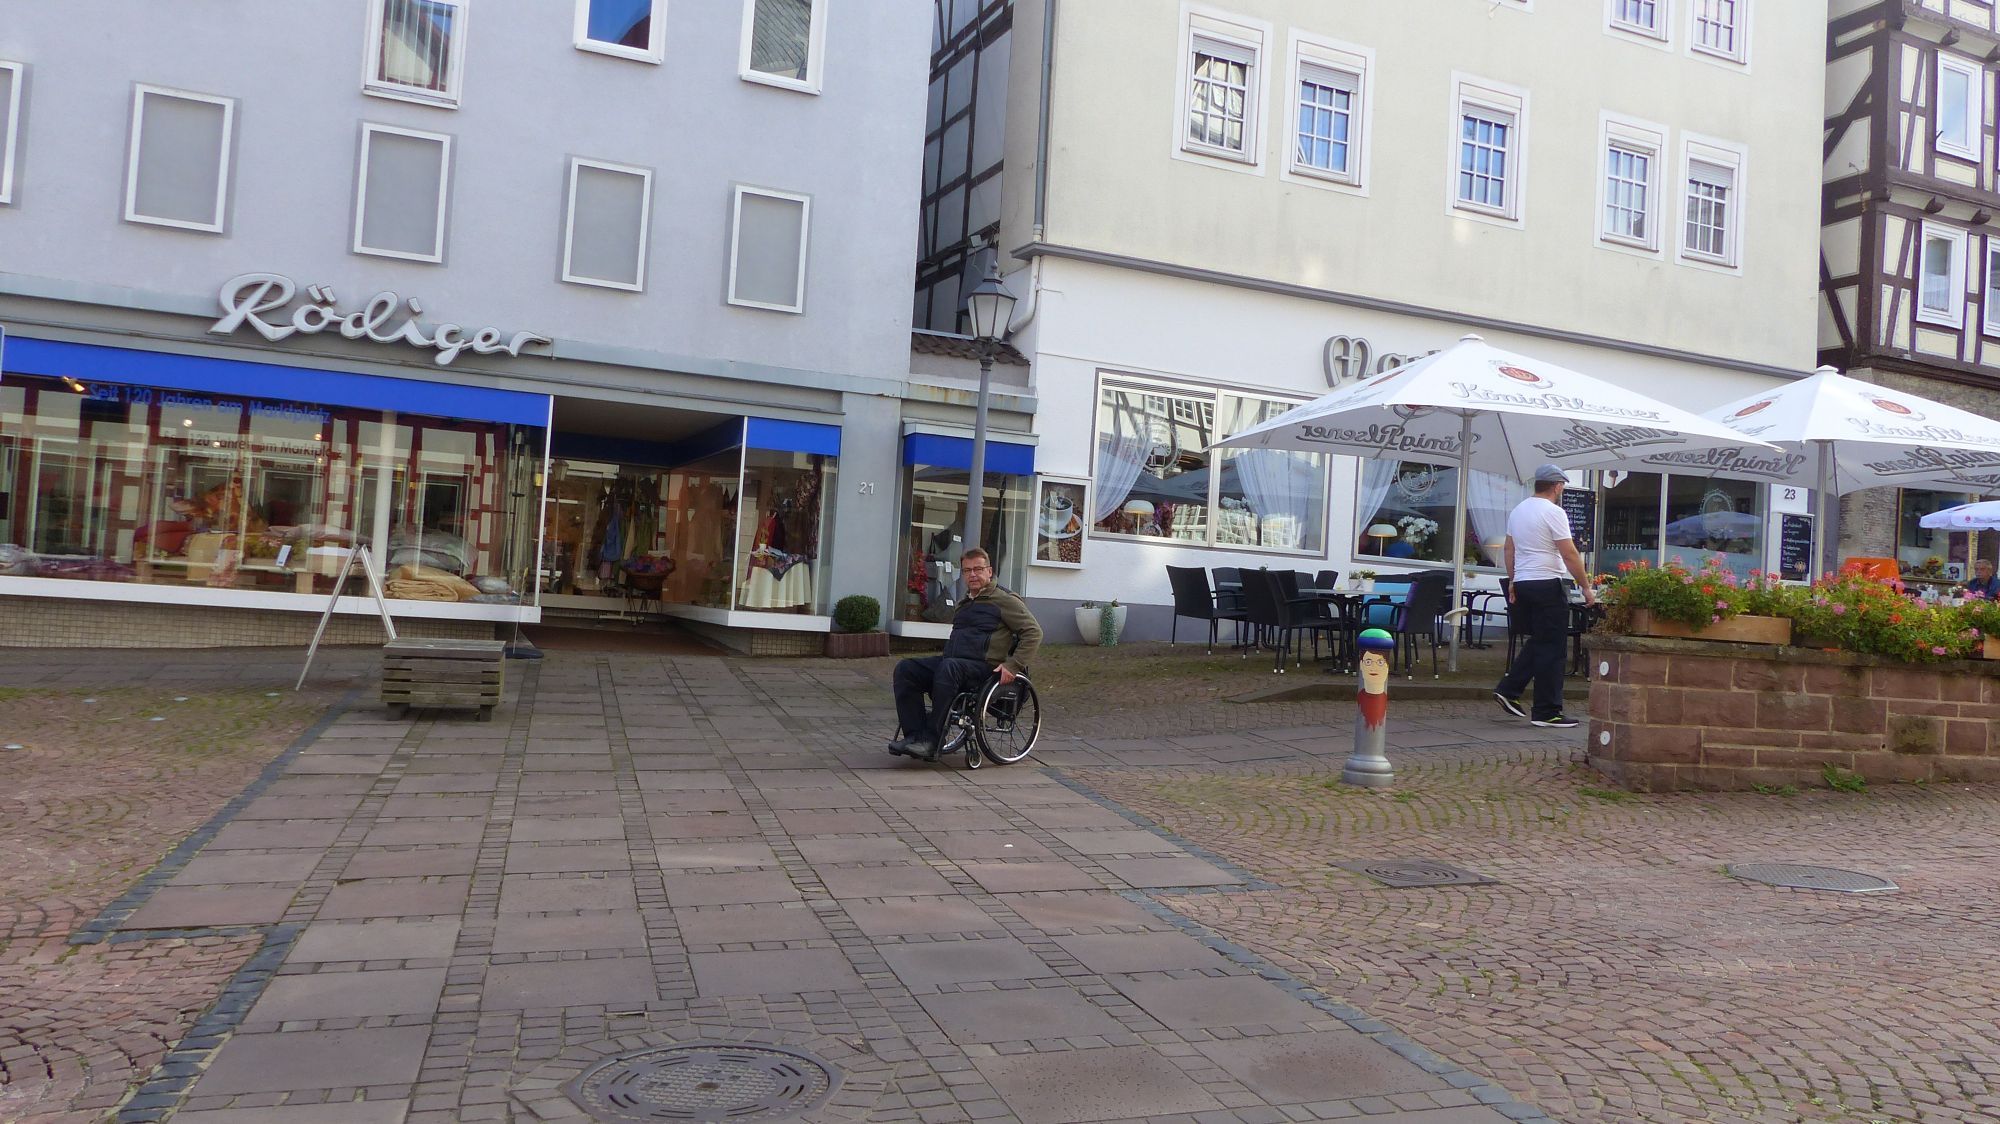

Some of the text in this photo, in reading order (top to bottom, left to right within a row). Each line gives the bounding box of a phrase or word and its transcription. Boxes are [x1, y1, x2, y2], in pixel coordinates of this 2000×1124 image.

[207, 272, 552, 366] Rödiger
[89, 383, 331, 424] Seit 120 Jahren am Marktplatz
[859, 481, 875, 495] 21
[1784, 488, 1796, 500] 23
